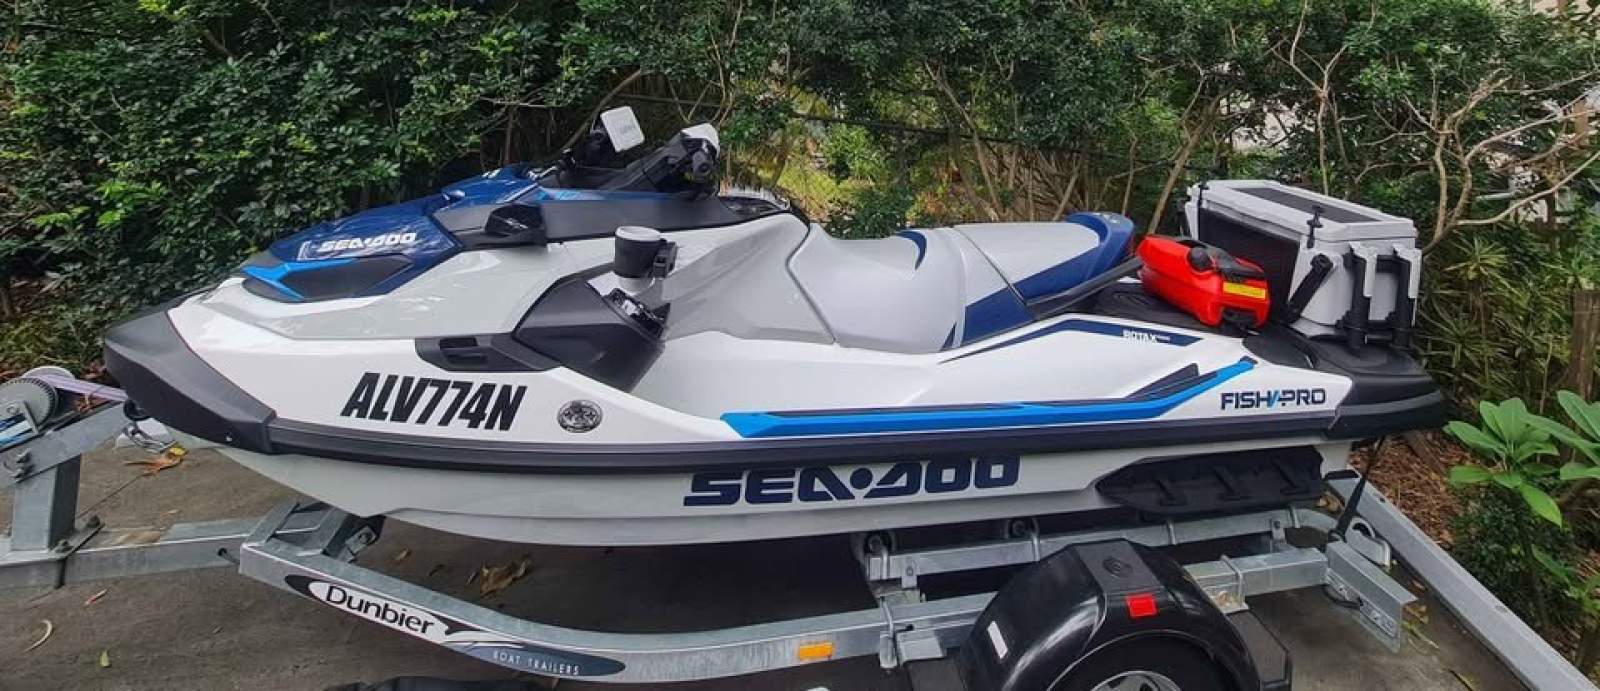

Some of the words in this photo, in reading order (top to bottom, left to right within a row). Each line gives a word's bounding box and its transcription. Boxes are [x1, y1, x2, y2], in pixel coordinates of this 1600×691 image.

[340, 372, 527, 431] ALV774N
[326, 585, 434, 633] Dunbier
[492, 650, 521, 664] BOAT
[527, 657, 580, 676] TRAILERS
